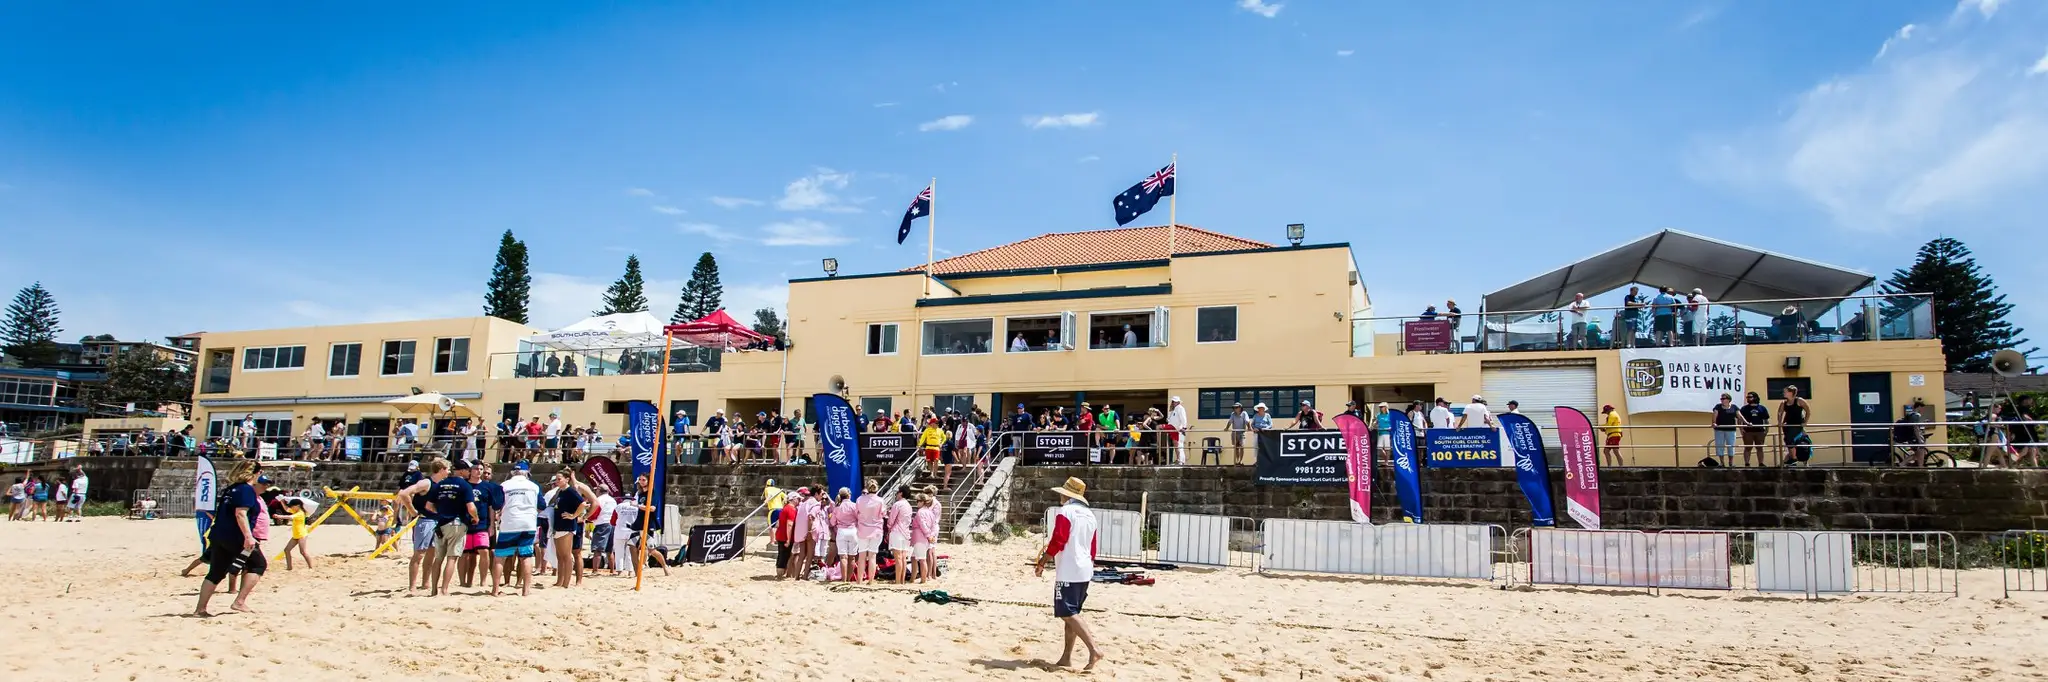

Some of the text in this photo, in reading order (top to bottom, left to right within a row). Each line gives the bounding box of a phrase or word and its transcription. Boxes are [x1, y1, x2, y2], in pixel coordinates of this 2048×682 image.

[1669, 362, 1742, 375] DAD & DAVE'S
[1670, 375, 1742, 392] BREWING
[642, 412, 652, 442] diggers
[831, 406, 842, 439] diggers
[840, 406, 852, 440] harbord
[1287, 438, 1347, 450] STONE
[1404, 421, 1412, 450] harbord
[1515, 422, 1528, 450] diggers
[1522, 422, 1537, 451] harbord
[1431, 450, 1497, 461] 100 YEARS
[1316, 466, 1336, 474] 2133
[706, 534, 732, 543] STONE
